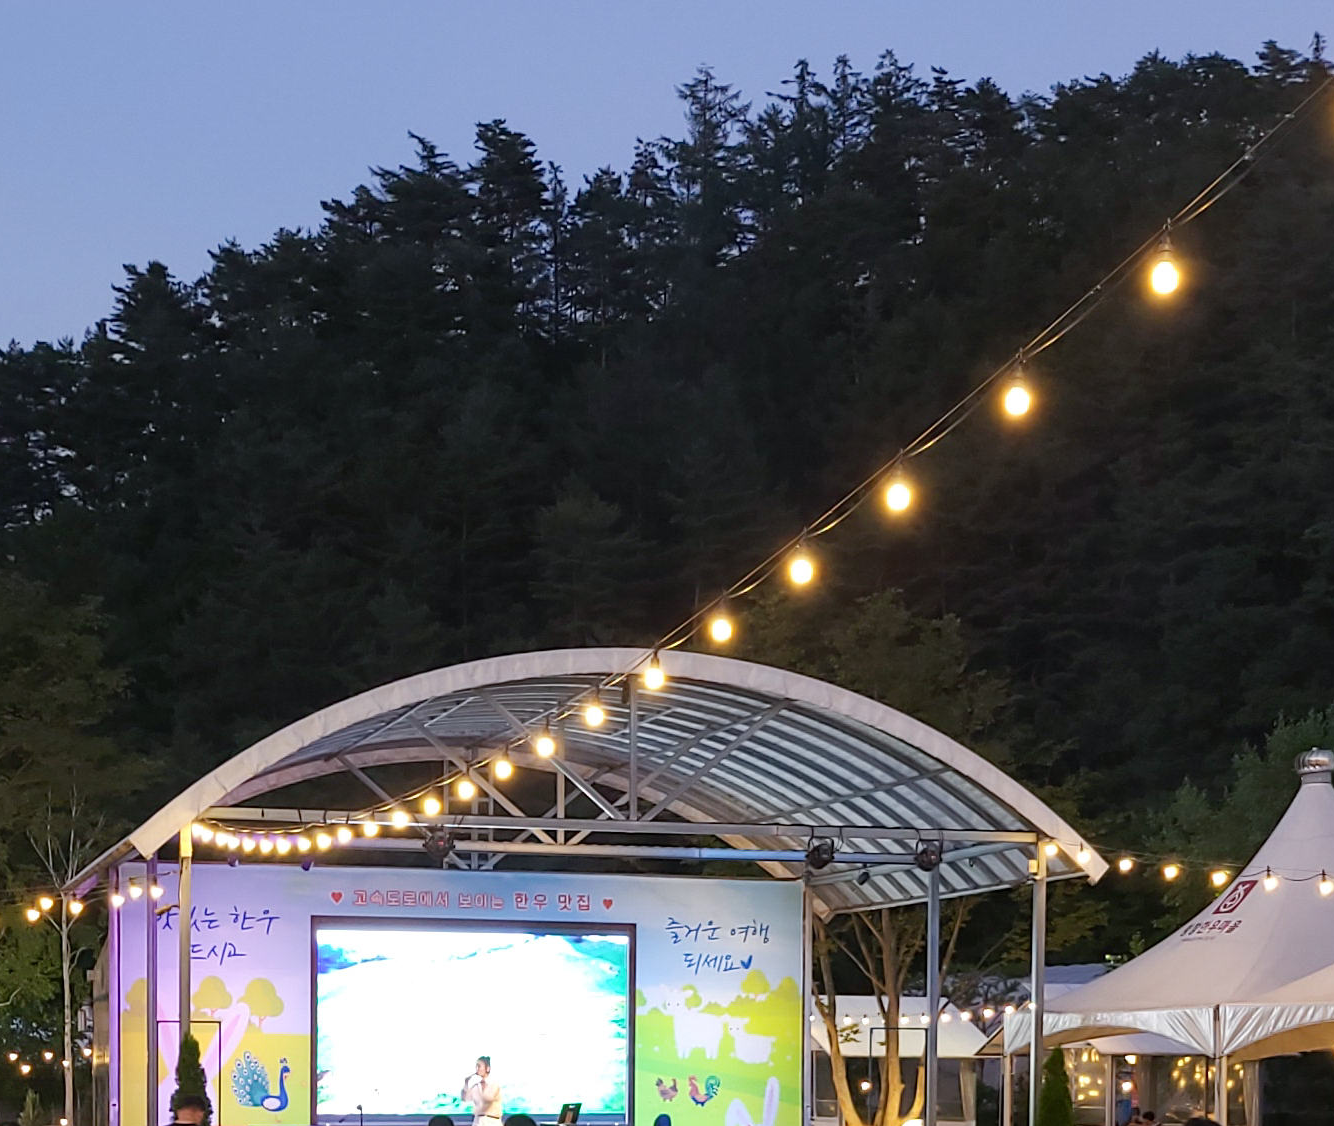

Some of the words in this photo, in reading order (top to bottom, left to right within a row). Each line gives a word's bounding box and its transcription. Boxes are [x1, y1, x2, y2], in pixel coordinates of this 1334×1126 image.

[353, 890, 450, 908] 고속도로에서
[458, 893, 505, 910] 보이는
[514, 892, 548, 911] 한우
[558, 894, 592, 911] 맛집
[229, 906, 280, 935] 한우
[665, 917, 722, 944] 즐거운
[730, 919, 769, 944] 여행
[683, 953, 741, 975] 되세요
